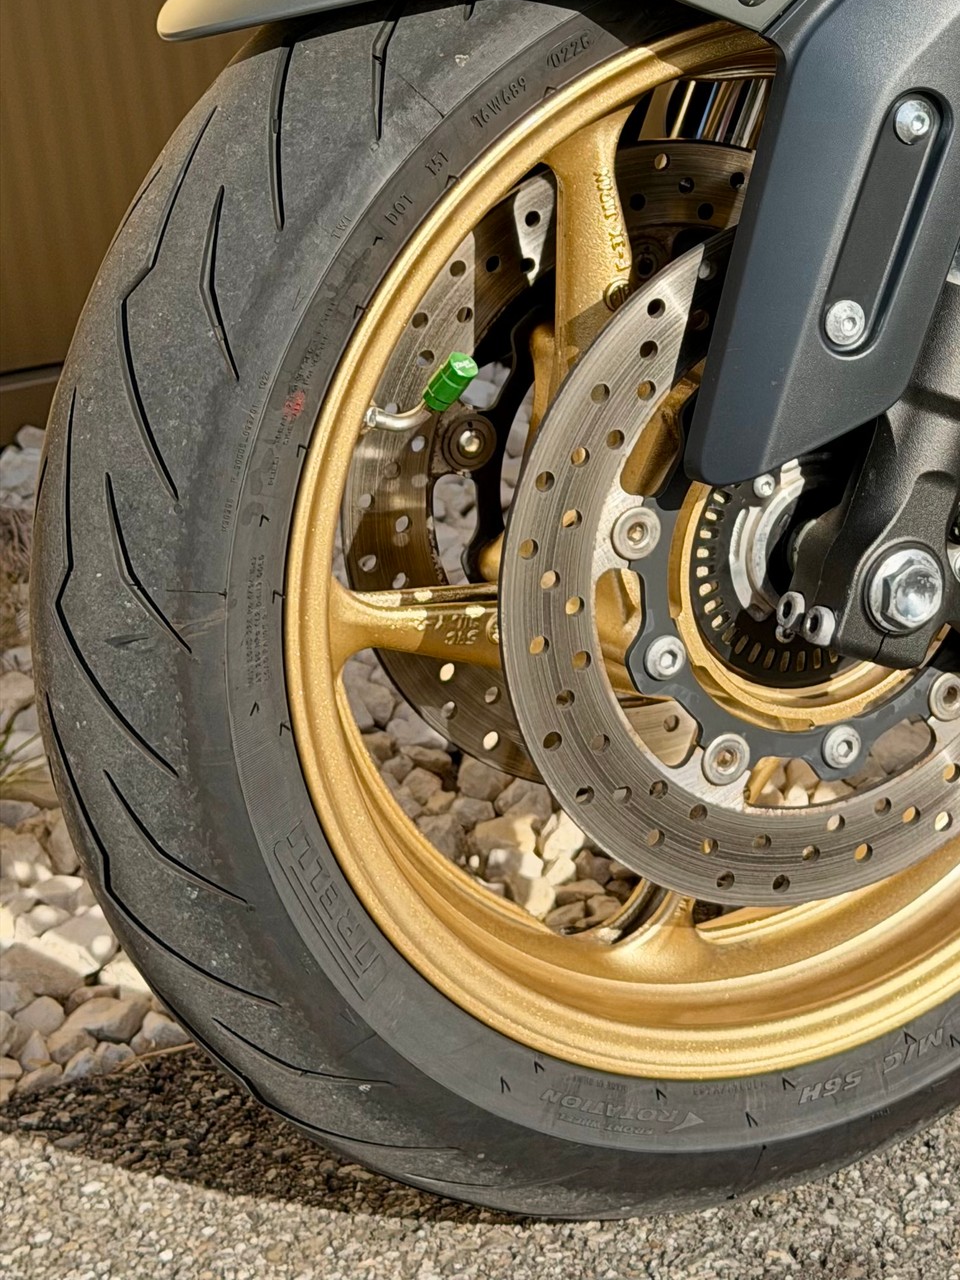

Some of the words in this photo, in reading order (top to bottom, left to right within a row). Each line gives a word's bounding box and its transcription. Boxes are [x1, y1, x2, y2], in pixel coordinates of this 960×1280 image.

[330, 214, 352, 239] TWI
[384, 195, 414, 225] DOT
[273, 819, 388, 1003] PIRELLI
[882, 1026, 944, 1076] M/C
[797, 1070, 864, 1105] 56H
[540, 1088, 682, 1122] ROTATION
[606, 1122, 655, 1136] FRONT
